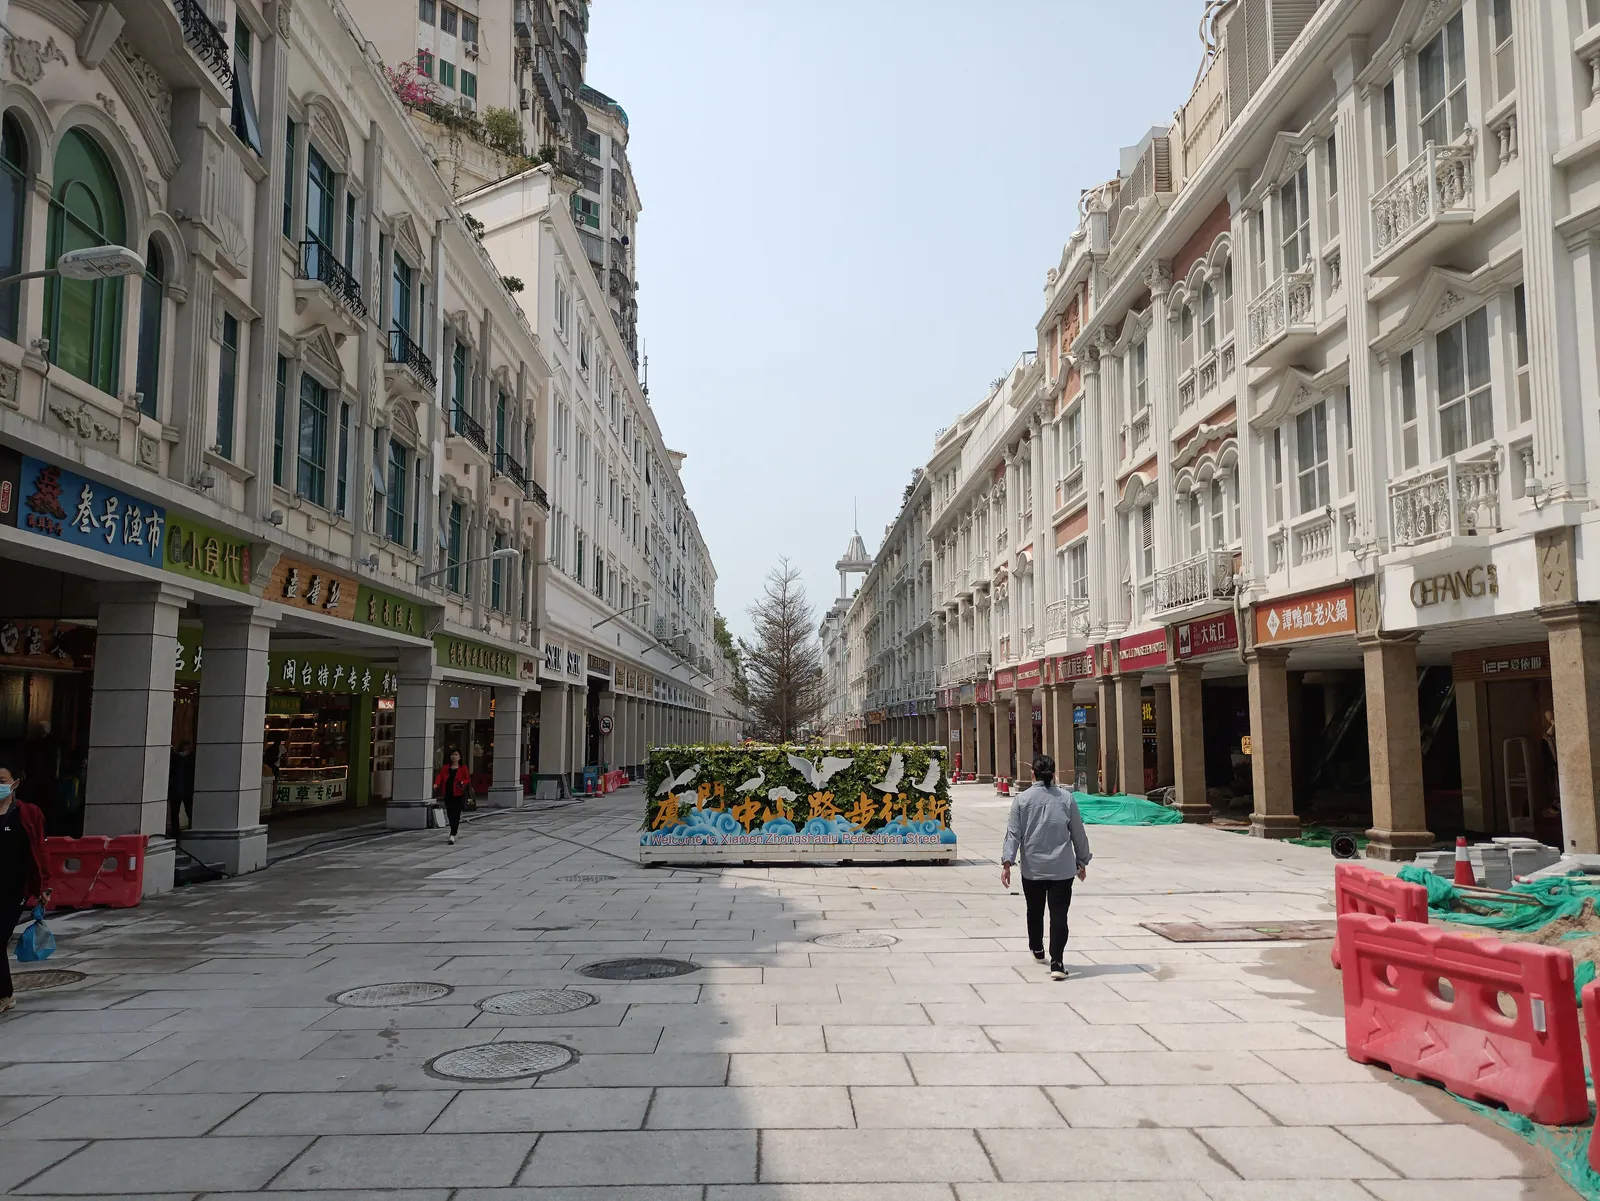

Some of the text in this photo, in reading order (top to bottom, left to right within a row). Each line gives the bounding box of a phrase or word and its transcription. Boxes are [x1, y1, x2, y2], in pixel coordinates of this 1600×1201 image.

[71, 484, 165, 558] 叁号渔市
[185, 532, 240, 583] 小食代
[1282, 598, 1348, 632] 譚鴨血老火鍋
[1201, 622, 1225, 644] 大坑口
[283, 659, 372, 693] 闽台特产专卖
[650, 833, 941, 846] Welcome to Xiamen Zhongshanlu Pedestrian Street
